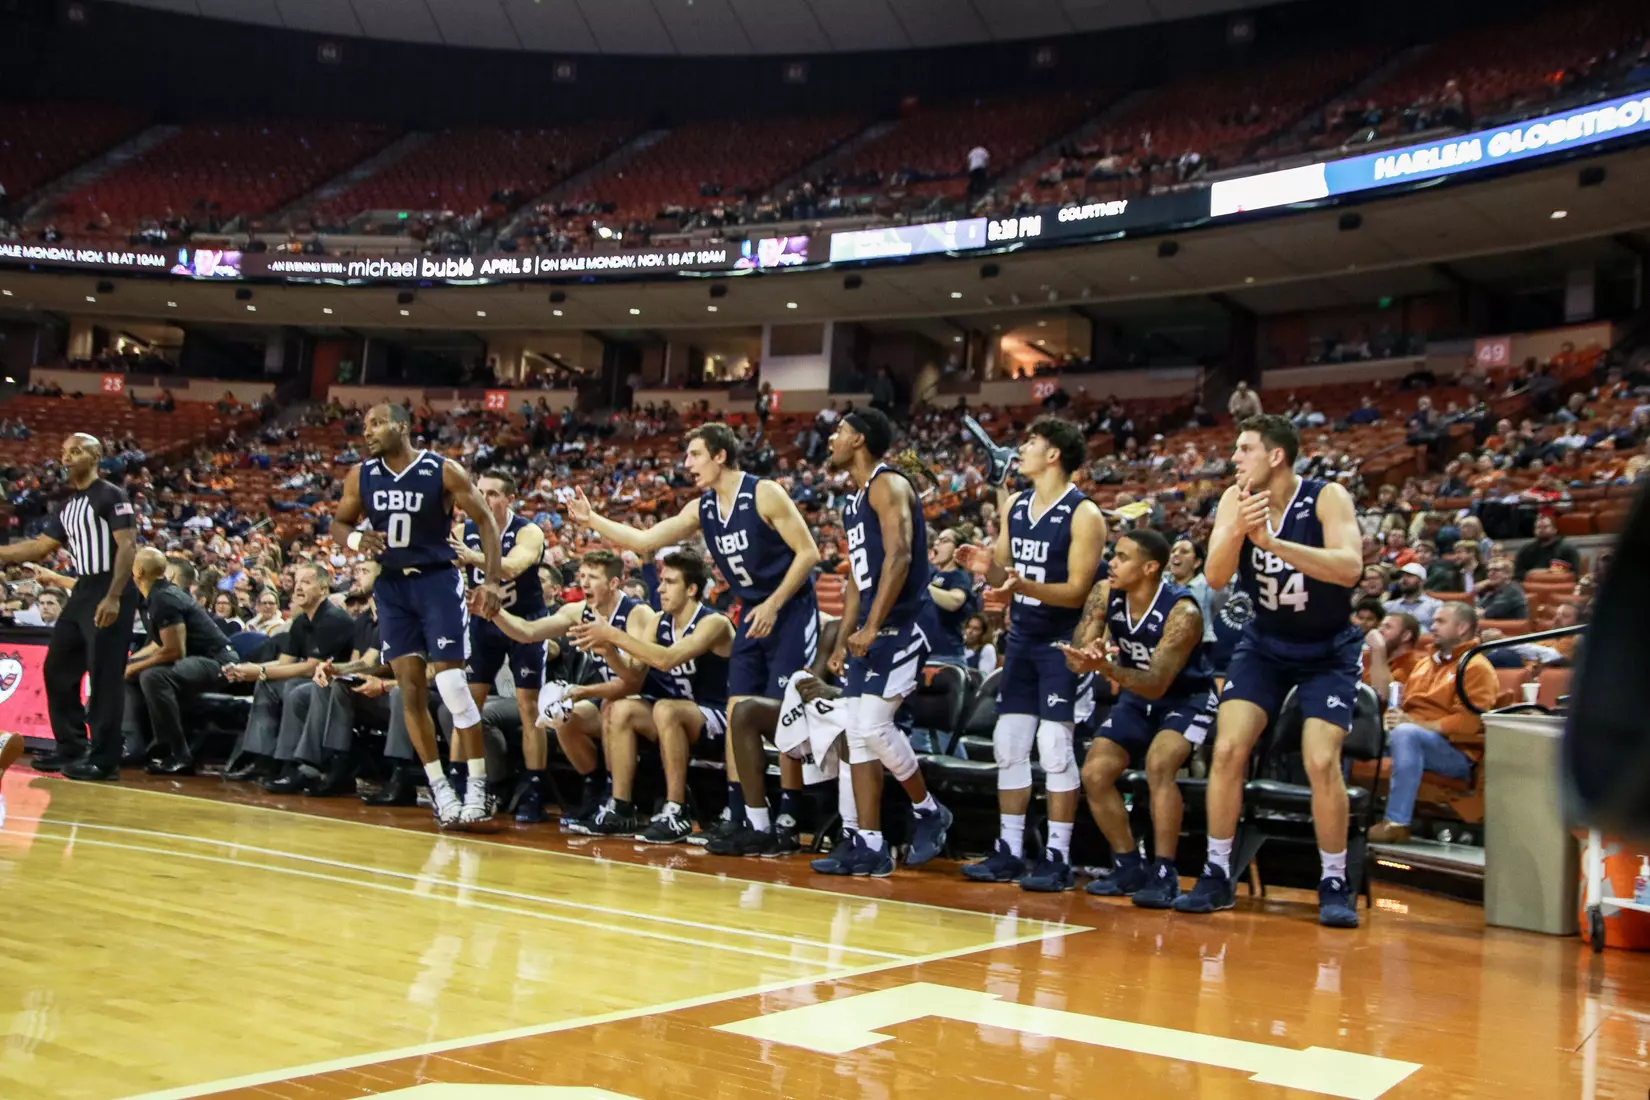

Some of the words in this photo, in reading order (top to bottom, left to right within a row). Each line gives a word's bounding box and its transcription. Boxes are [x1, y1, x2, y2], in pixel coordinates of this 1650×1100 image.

[1374, 138, 1482, 180] HARLEM
[1058, 200, 1128, 222] COURTNEY
[1019, 215, 1041, 238] PM
[76, 249, 105, 263] NOV.
[107, 251, 119, 264] 18
[120, 252, 135, 265] AT
[136, 253, 165, 266] 10AM
[348, 258, 418, 277] michael
[480, 258, 520, 275] APRIL
[522, 257, 532, 273] 5
[541, 258, 558, 271] ON
[560, 257, 585, 271] SALE
[586, 255, 636, 269] MONDAY,
[637, 253, 665, 268] NOV.
[667, 252, 680, 266] 18
[680, 251, 695, 265] AT
[697, 250, 726, 264] 10AM
[488, 394, 505, 409] 22
[1033, 383, 1055, 399] 20
[373, 490, 424, 512] CBU
[387, 512, 412, 548] 0
[714, 529, 749, 554] CBU
[1011, 536, 1050, 563] CBU
[1252, 546, 1295, 574] CB
[727, 554, 753, 587] 5
[1255, 572, 1309, 612] 34
[1119, 637, 1156, 662] CB
